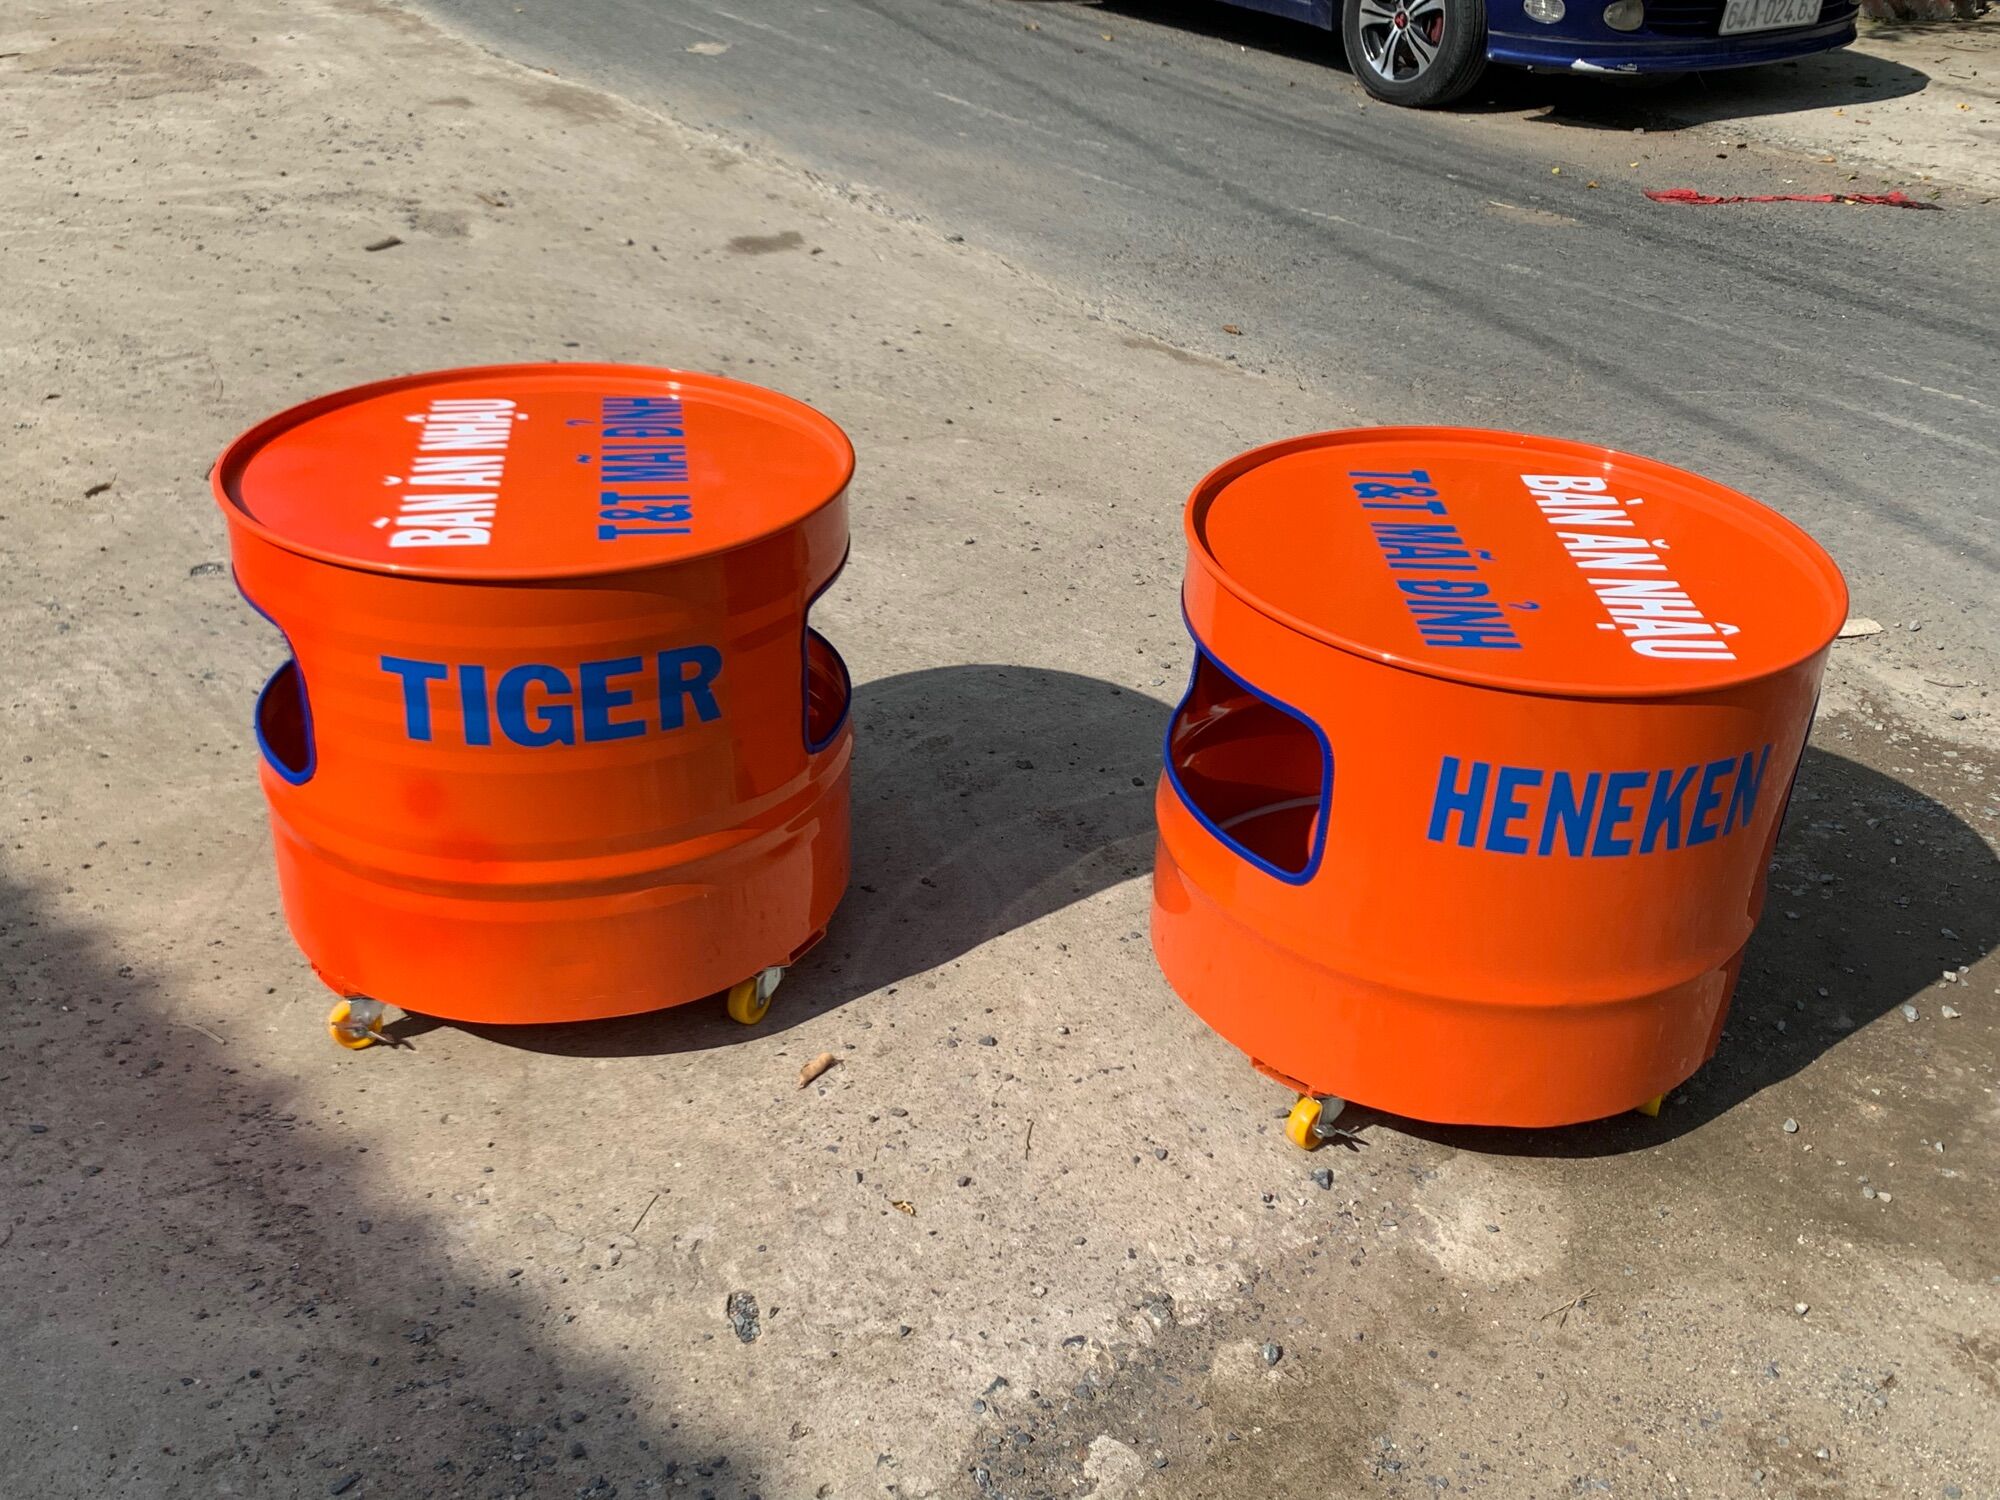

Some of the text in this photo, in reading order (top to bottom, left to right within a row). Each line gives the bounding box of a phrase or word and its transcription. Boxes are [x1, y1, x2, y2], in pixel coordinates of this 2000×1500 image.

[371, 398, 529, 548] BÀN ĂN NHẬU
[565, 397, 693, 541] T&T MÃI ĐỈNH
[1348, 469, 1540, 650] T&T MÃI ĐỈNH
[1520, 474, 1741, 660] BÀN ĂN NHẬU
[380, 644, 723, 747] TIGER
[1427, 743, 1771, 857] HENEKEN
